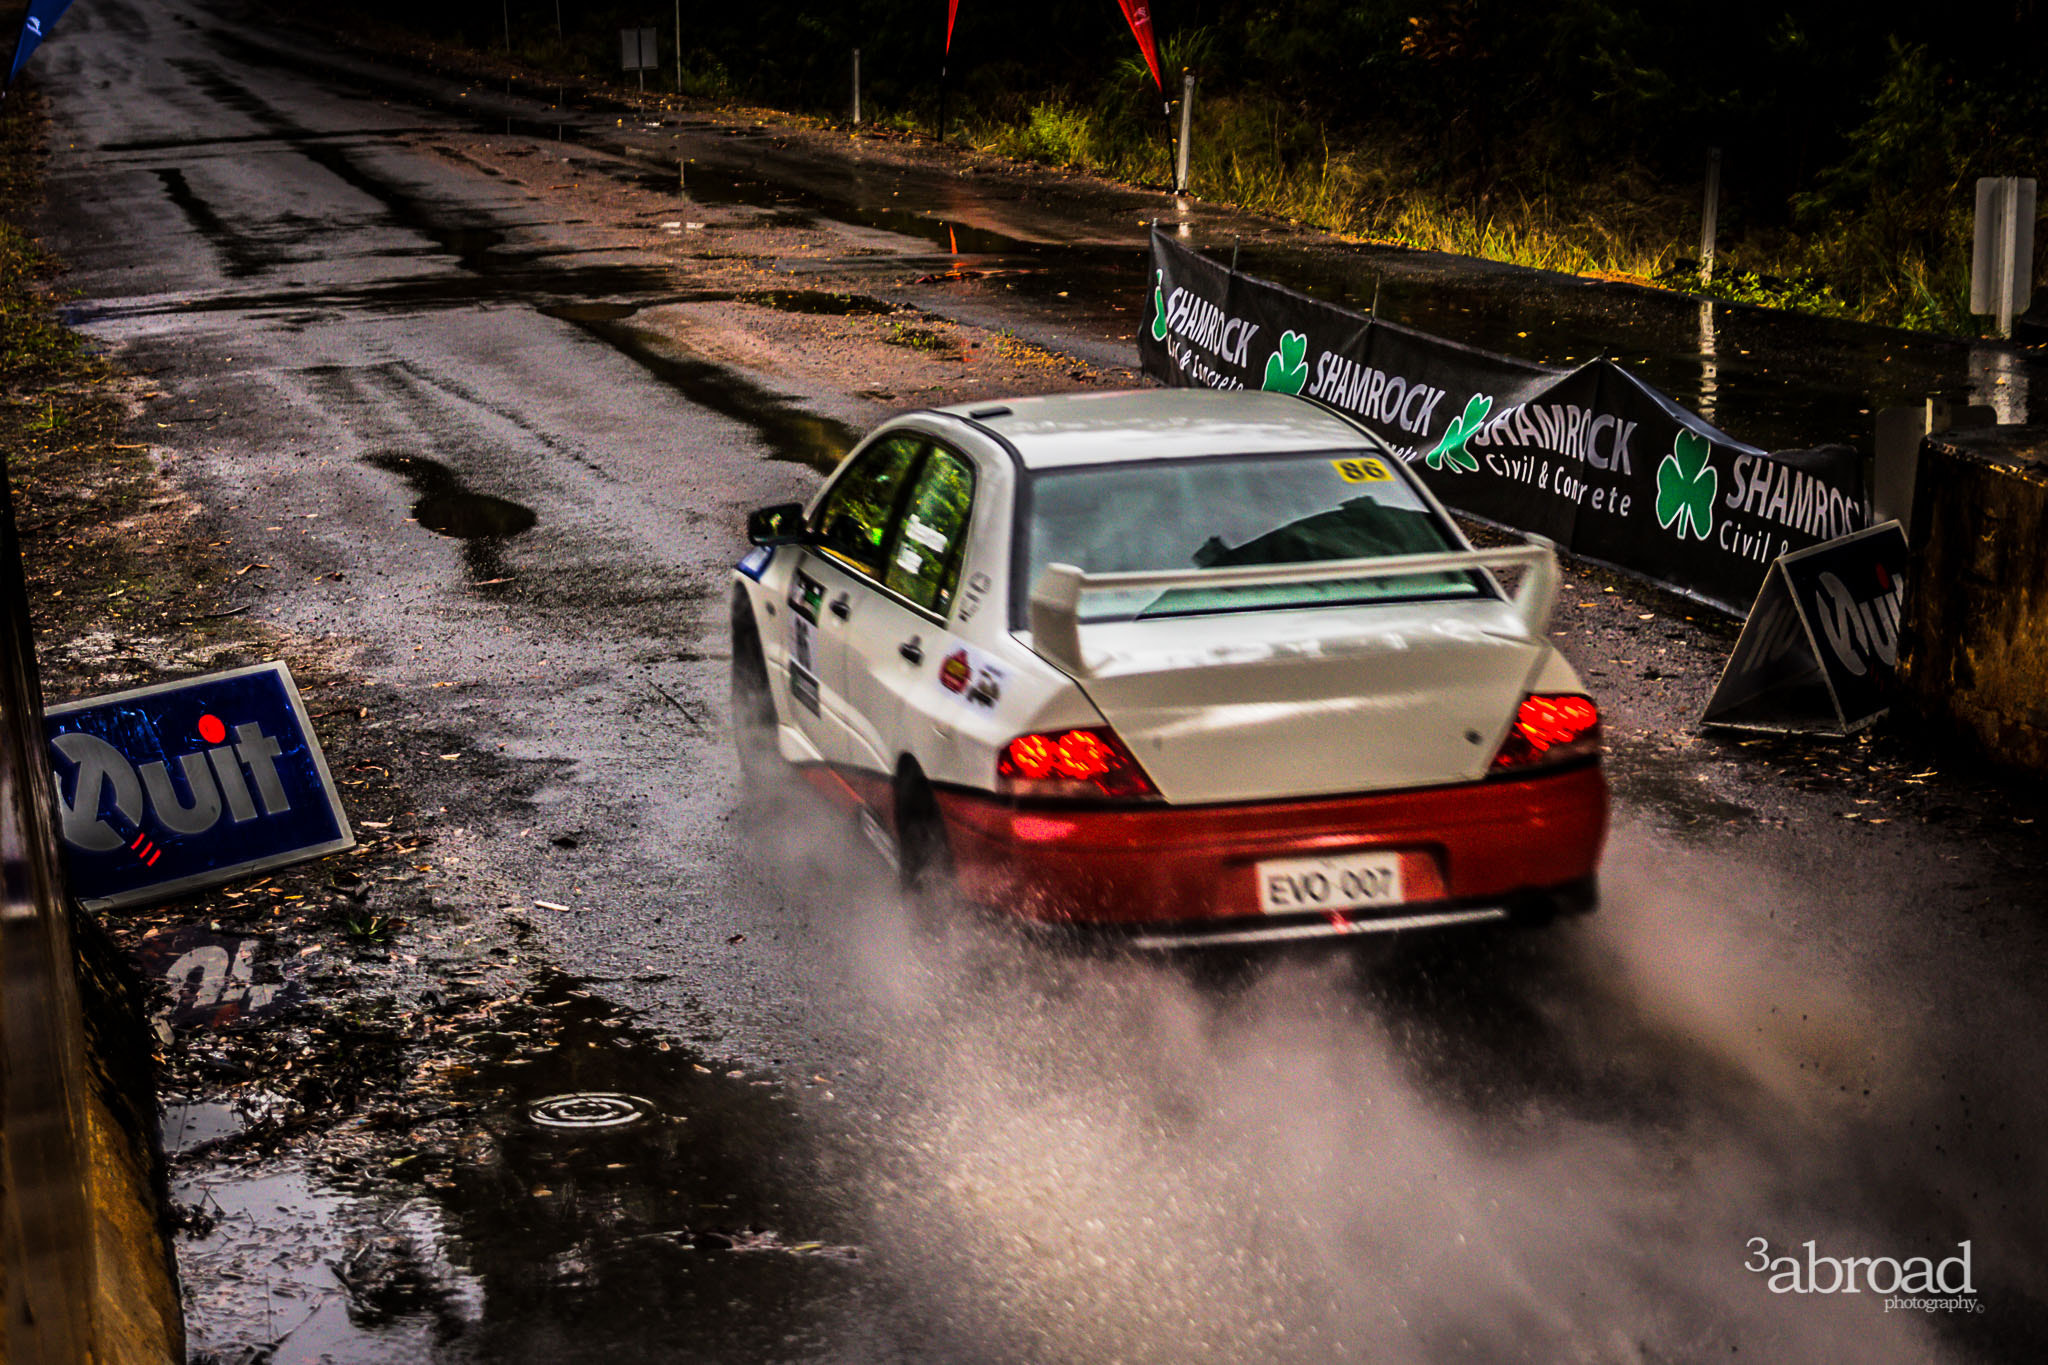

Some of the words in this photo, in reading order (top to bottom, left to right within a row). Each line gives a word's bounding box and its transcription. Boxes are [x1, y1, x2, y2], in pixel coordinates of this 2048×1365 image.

[1167, 287, 1259, 368] SHAMROCK
[1308, 351, 1446, 436] SHAMROCK
[1339, 461, 1386, 480] 86
[1475, 403, 1638, 476] SHAMROCK
[1486, 454, 1535, 484] Civil
[1538, 460, 1549, 489] &
[1725, 454, 1861, 541] SHAMROC
[1719, 519, 1772, 564] Civil
[51, 714, 291, 851] Quit
[1268, 872, 1331, 905] EVO
[1341, 866, 1393, 900] 007
